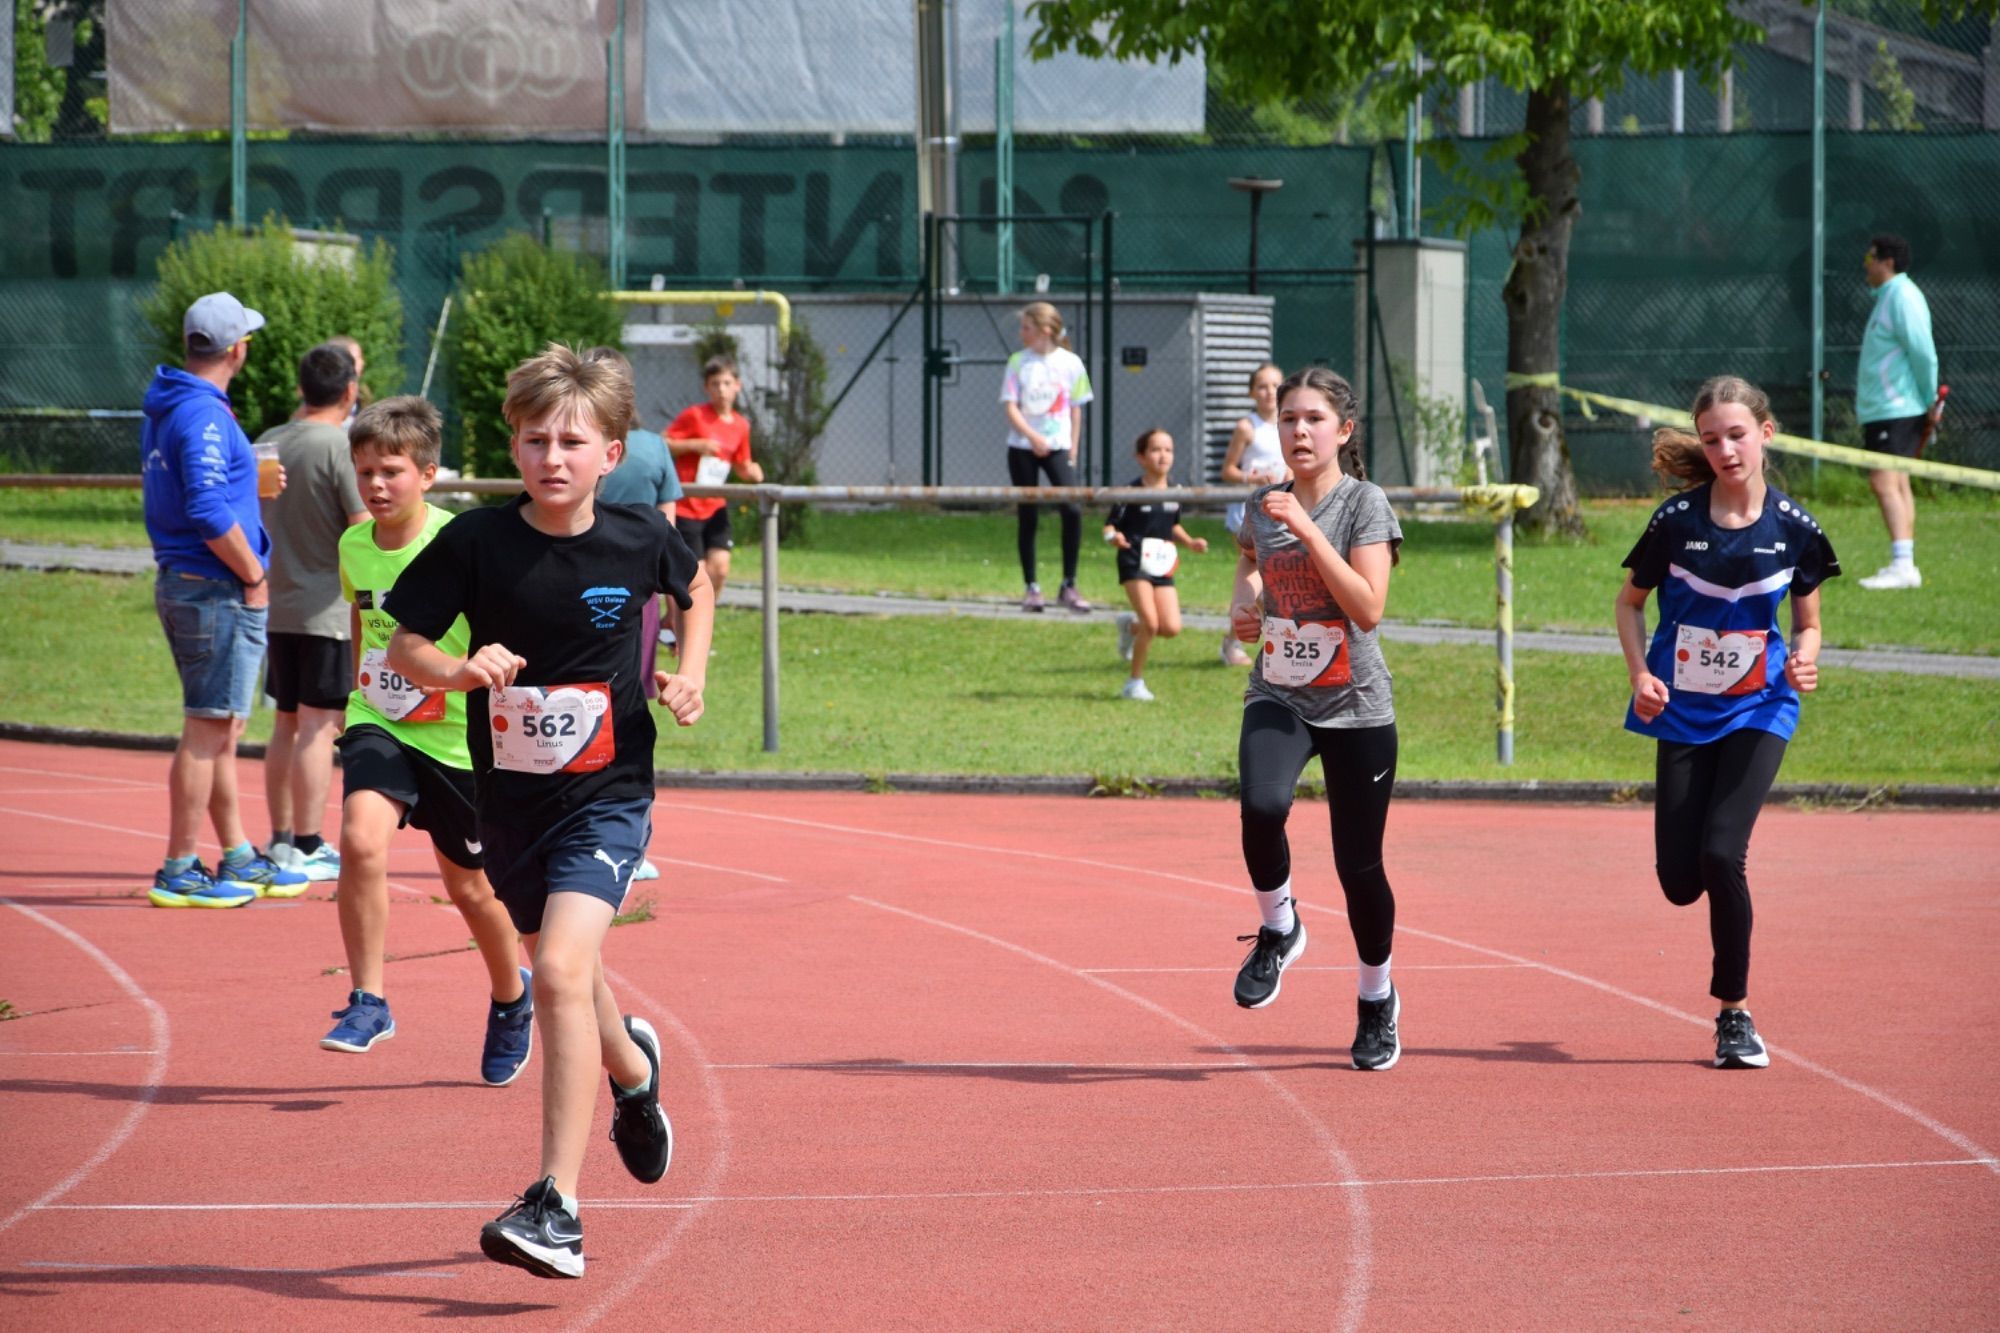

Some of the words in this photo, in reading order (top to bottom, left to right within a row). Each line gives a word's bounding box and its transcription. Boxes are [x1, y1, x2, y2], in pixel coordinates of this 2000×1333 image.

[1685, 541, 1709, 551] JAKO
[1273, 574, 1315, 592] with
[1281, 593, 1315, 609] me
[368, 618, 381, 628] VS
[1283, 641, 1321, 660] 525
[1700, 650, 1740, 669] 542
[522, 713, 577, 738] 562
[536, 739, 564, 748] Linus
